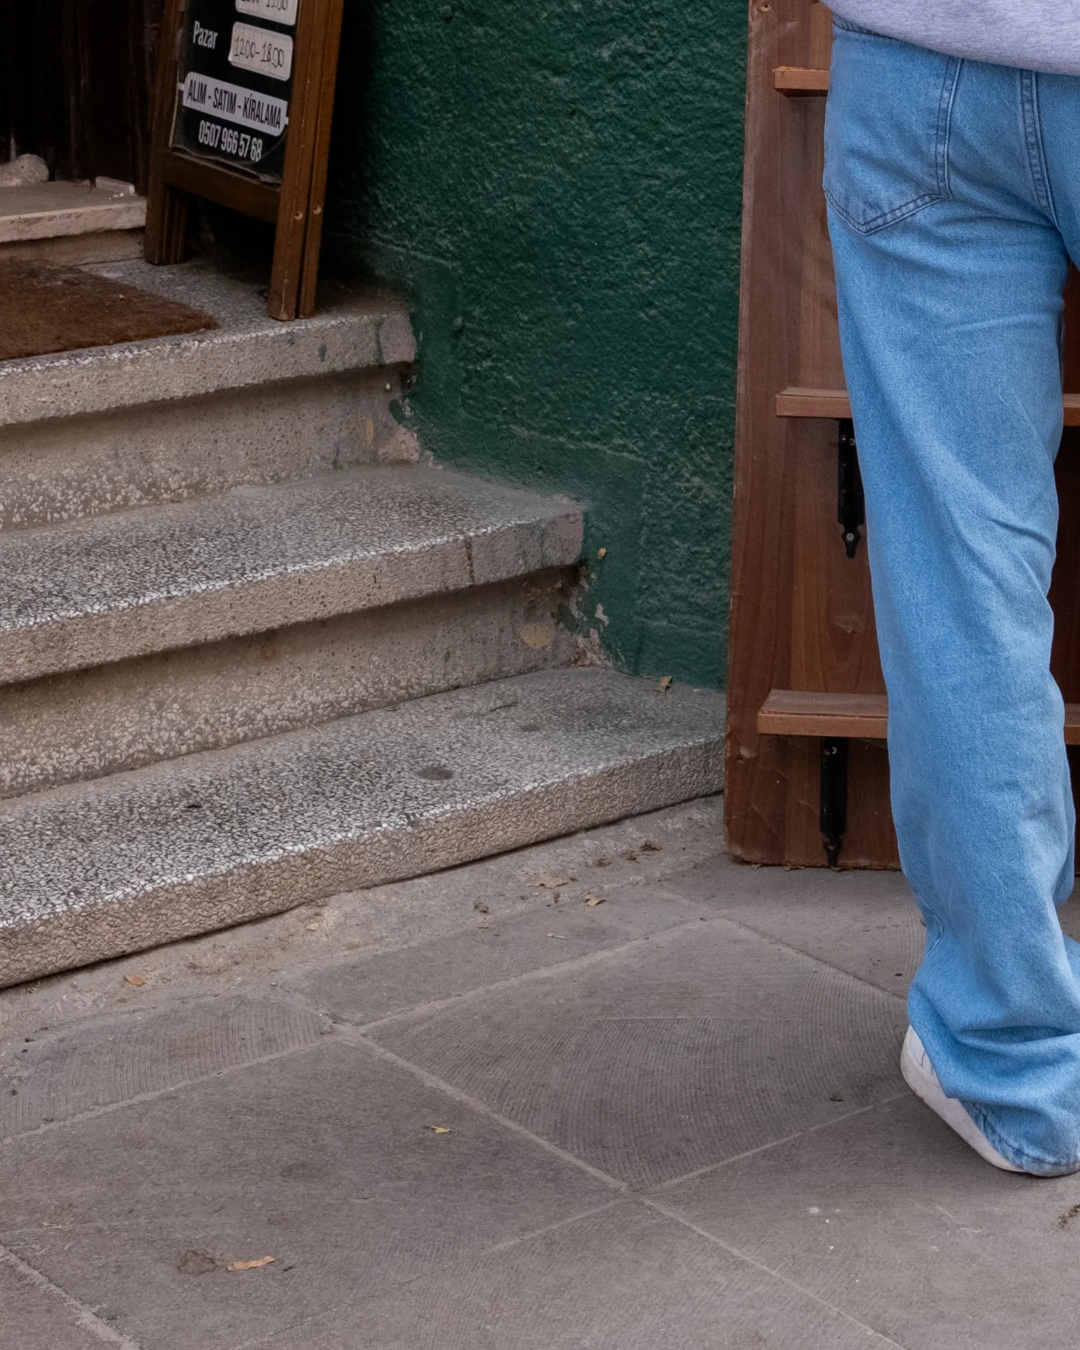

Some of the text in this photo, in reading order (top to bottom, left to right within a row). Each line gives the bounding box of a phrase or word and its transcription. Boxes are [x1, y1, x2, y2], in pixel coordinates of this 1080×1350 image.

[192, 20, 218, 49] Pazar
[187, 79, 208, 105] ALIM
[213, 87, 237, 114] SATIM
[243, 93, 281, 129] KİRALAMA
[198, 120, 263, 162] 0507 966 57 68
